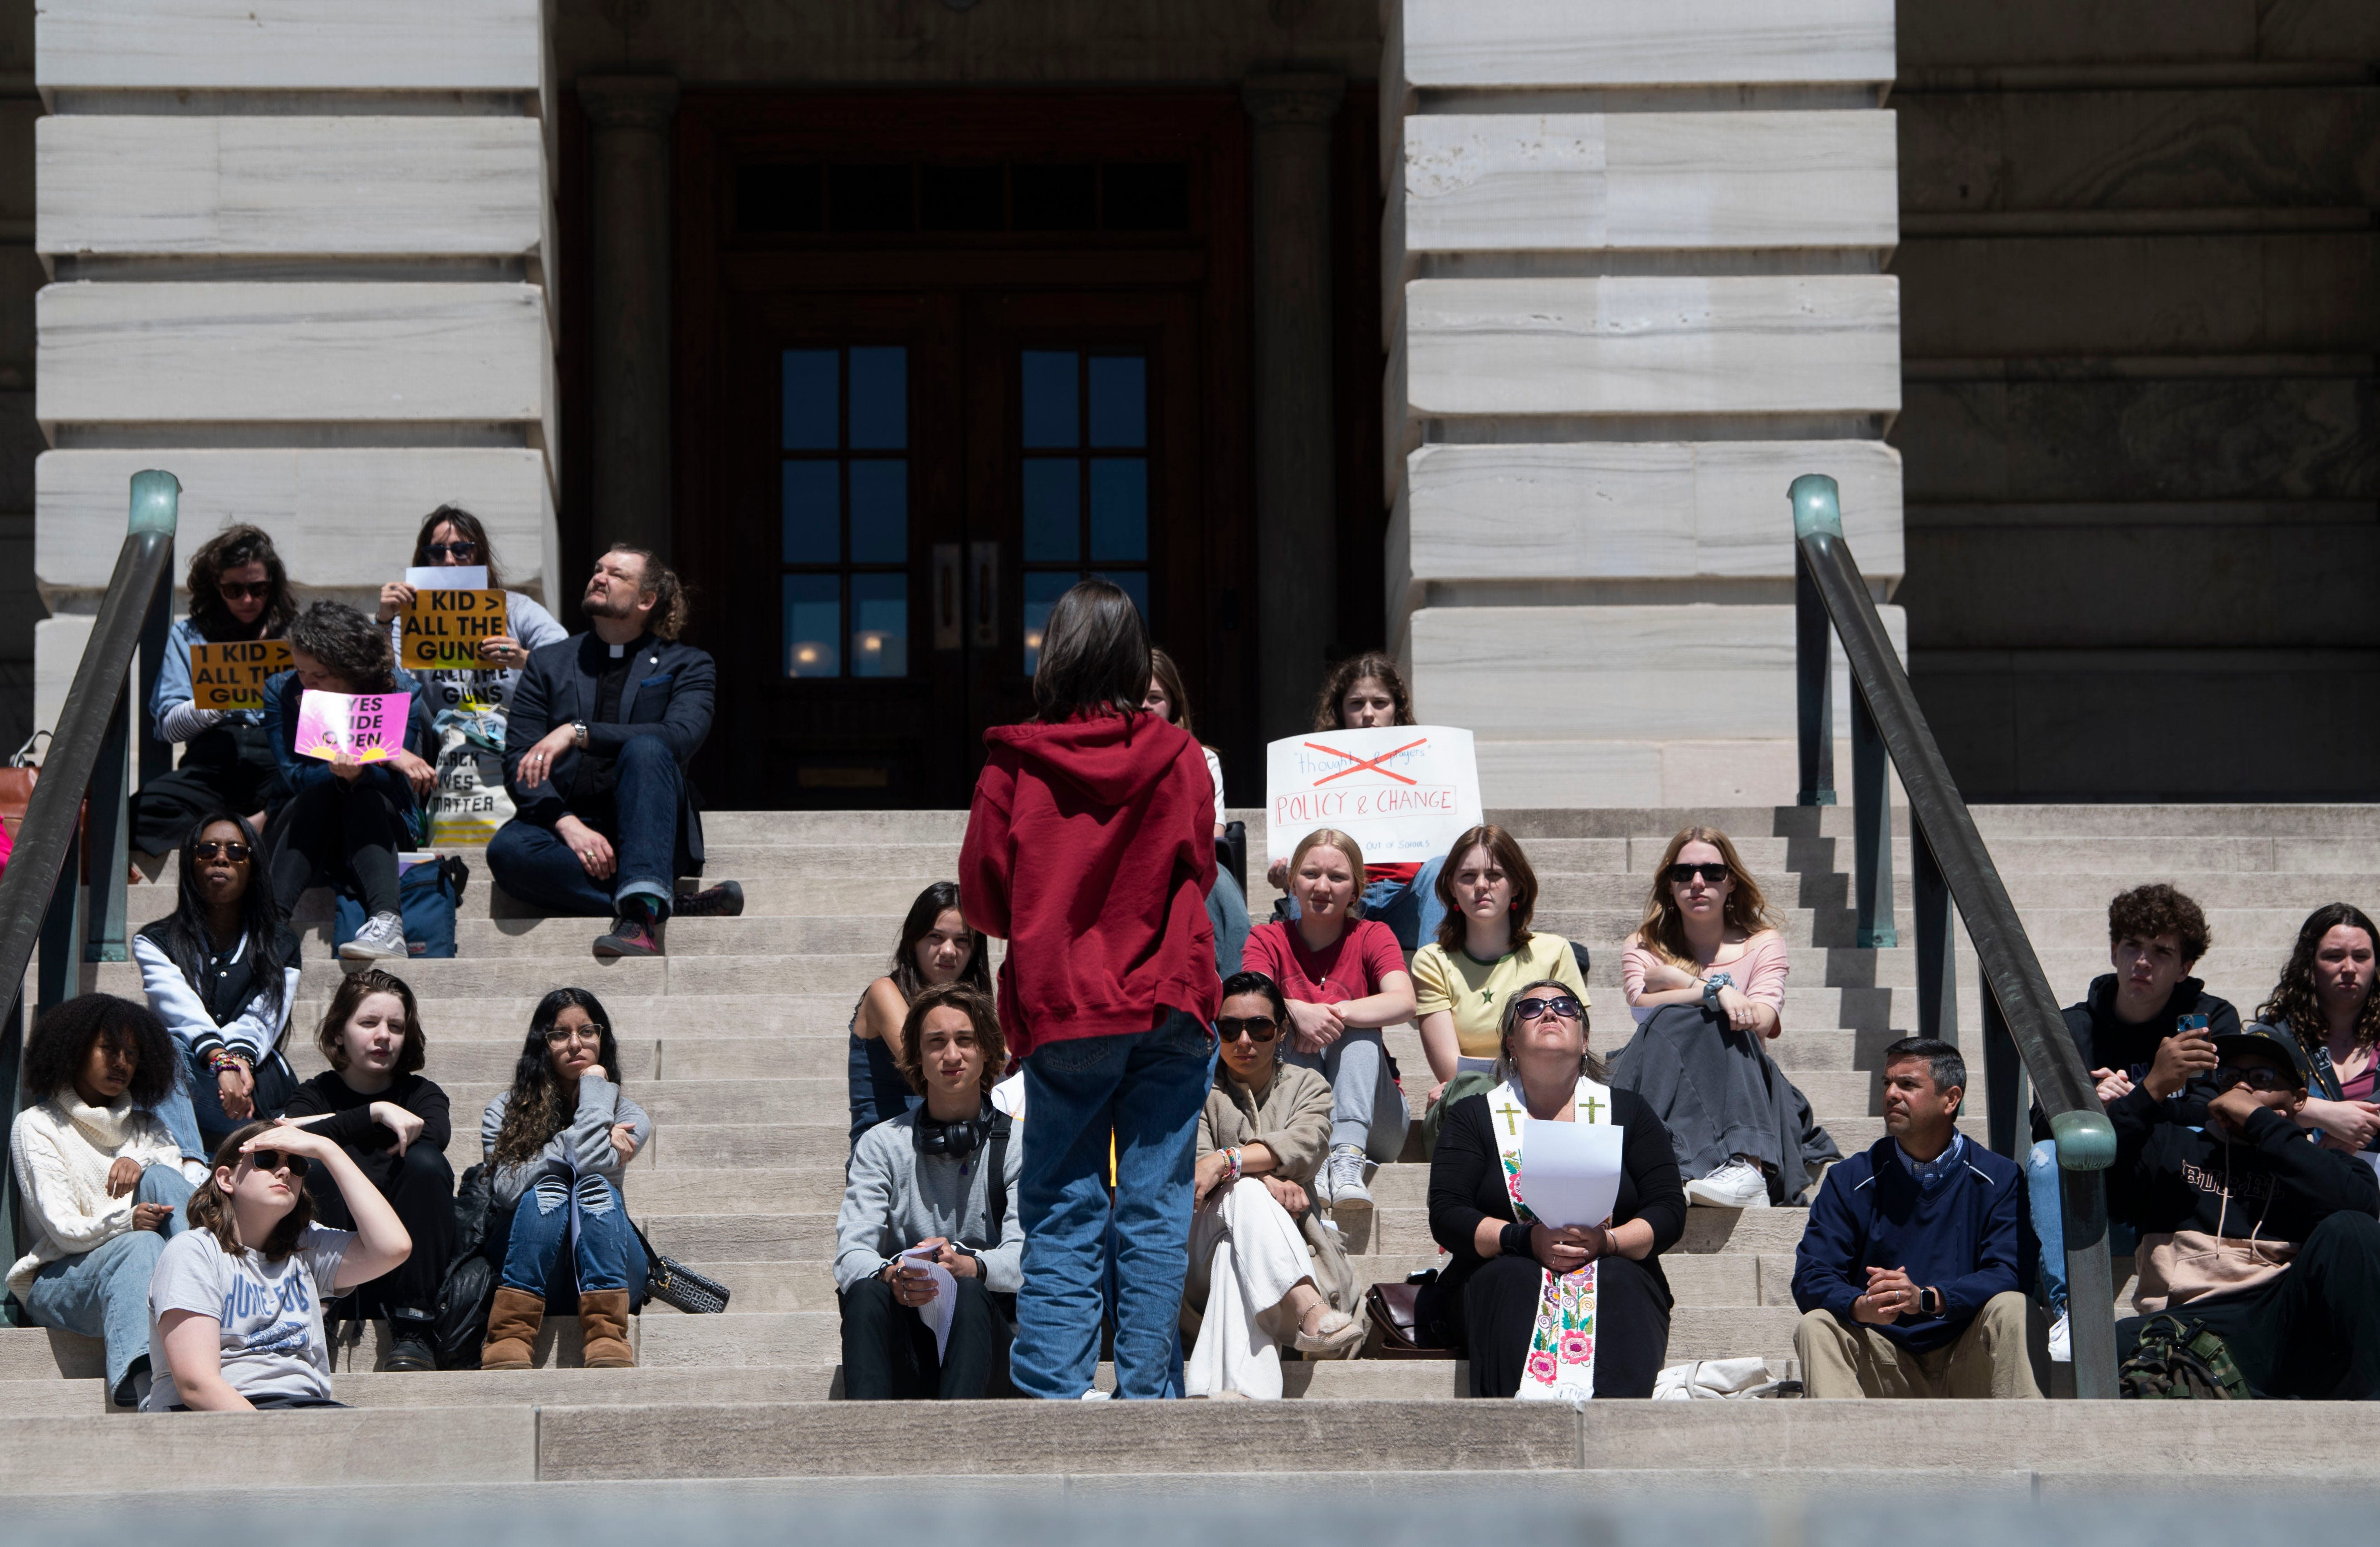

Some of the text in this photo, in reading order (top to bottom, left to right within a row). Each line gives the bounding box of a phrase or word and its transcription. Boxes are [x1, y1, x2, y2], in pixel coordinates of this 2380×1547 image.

[431, 591, 475, 611] KID
[404, 616, 502, 635] ALL THE
[198, 645, 208, 663] 1
[222, 643, 267, 662] KID
[196, 664, 294, 684] ALL TH
[431, 669, 465, 682] ALL
[209, 688, 264, 703] GUN
[442, 685, 503, 704] GUNS
[346, 714, 383, 730] IDE
[437, 751, 479, 767] BLACK
[1373, 751, 1383, 765] &
[438, 773, 473, 790] IVES
[432, 796, 494, 812] MATTER
[1277, 789, 1452, 824] POLICY & CHANGE
[1366, 841, 1382, 851] OUT
[1398, 839, 1430, 849] SCHOOLS
